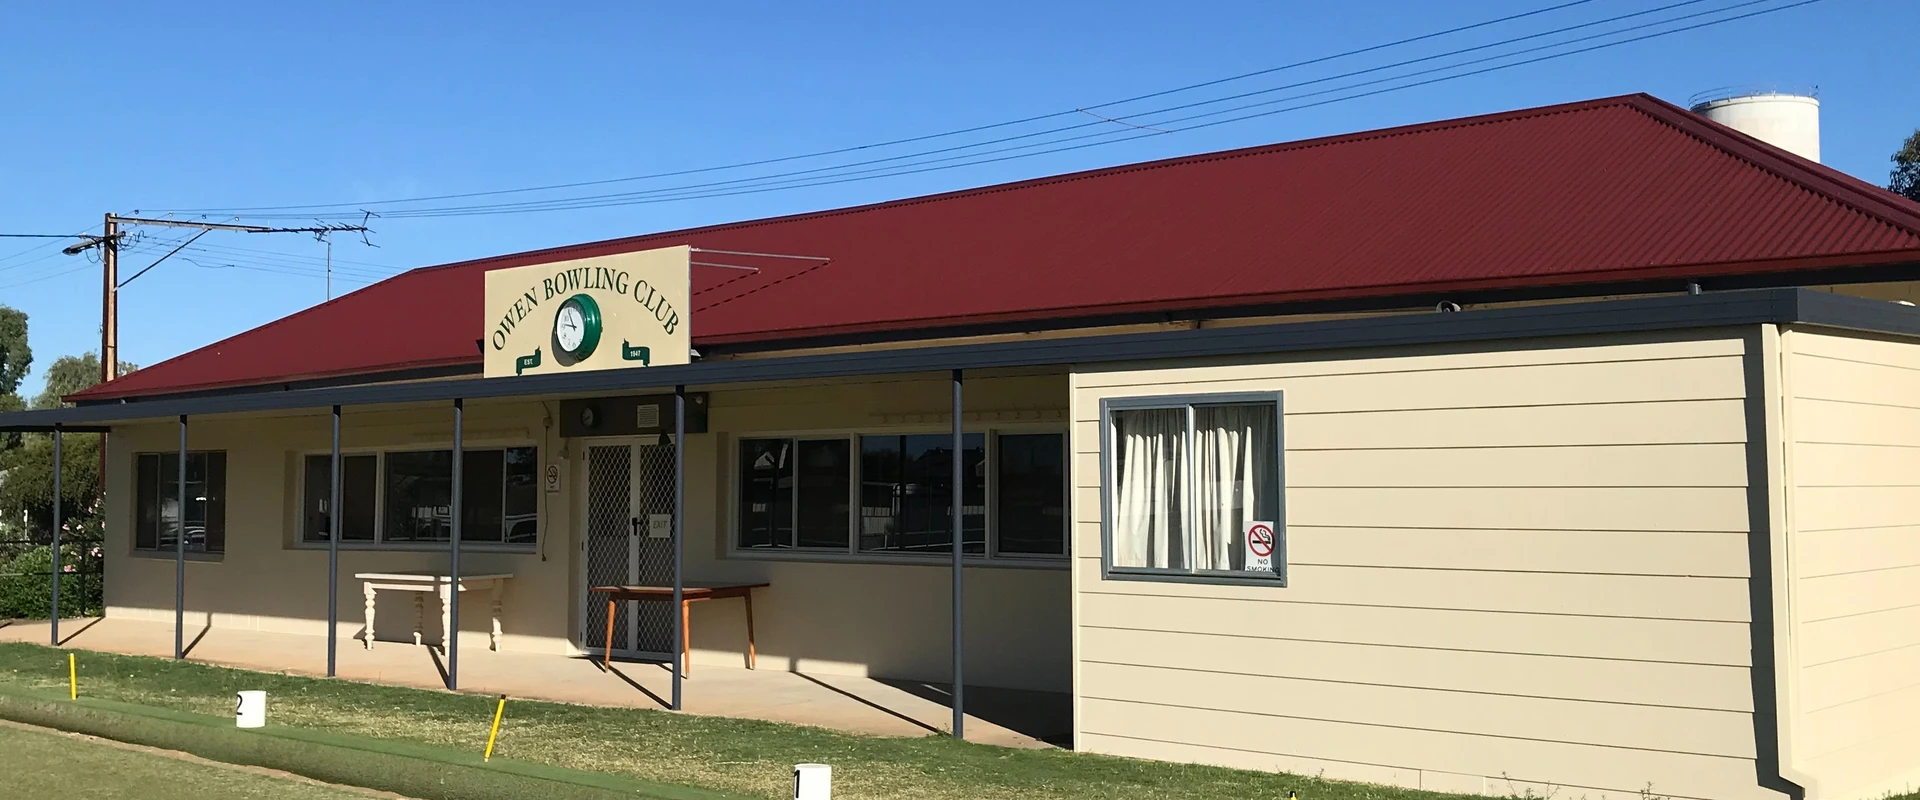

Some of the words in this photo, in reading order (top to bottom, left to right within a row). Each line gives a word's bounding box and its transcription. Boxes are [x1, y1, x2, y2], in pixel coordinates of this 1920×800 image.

[492, 286, 538, 351] OWEN
[542, 266, 629, 301] BOWLING
[633, 280, 679, 335] CLUB
[653, 520, 667, 529] EXIT
[236, 693, 243, 716] 2
[794, 769, 800, 799] 1
